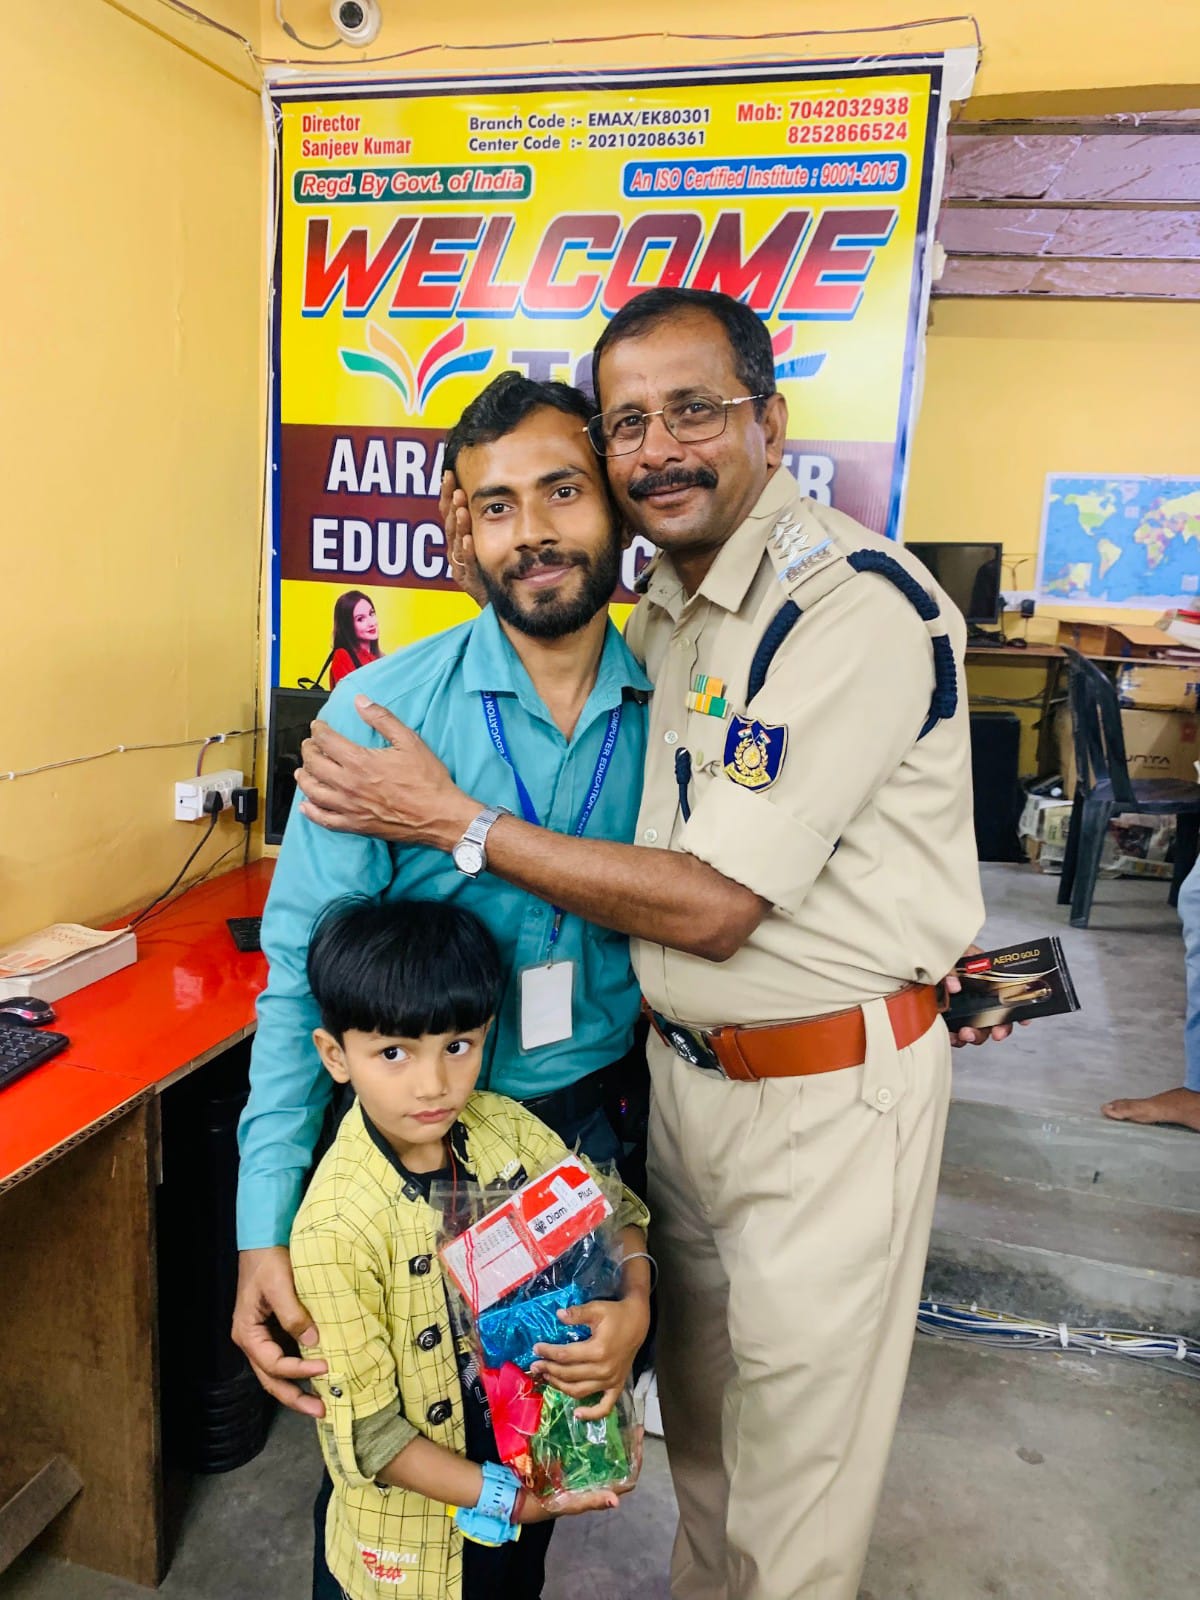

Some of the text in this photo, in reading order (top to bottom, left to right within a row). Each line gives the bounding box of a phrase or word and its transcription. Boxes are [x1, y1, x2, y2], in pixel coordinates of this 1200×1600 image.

[469, 116, 522, 131] Branch
[528, 114, 566, 129] Code
[588, 109, 710, 128] EMAX/EK80301
[737, 97, 909, 122] Mob: 7042032938
[302, 114, 361, 133] Director
[788, 122, 907, 144] 8252866524
[302, 137, 412, 160] Sanjeev Kumar
[469, 137, 518, 151] Center
[523, 134, 561, 149] Code
[588, 131, 705, 149] 202102086361
[302, 171, 525, 197] Regd. By Govt. of India
[630, 169, 652, 191] An
[656, 168, 679, 190] ISO
[684, 165, 744, 190] Certified
[749, 163, 808, 187] Institute
[821, 161, 899, 185] 9001-2015
[302, 211, 896, 318] WELCOME
[511, 350, 595, 400] T
[312, 517, 454, 579] EDUC
[485, 701, 505, 754] EDUCATION
[575, 705, 621, 838] COMPUTER EDUCATION CENT
[993, 953, 1019, 965] AERO
[1021, 949, 1040, 959] GOLD
[578, 1187, 593, 1200] Plus
